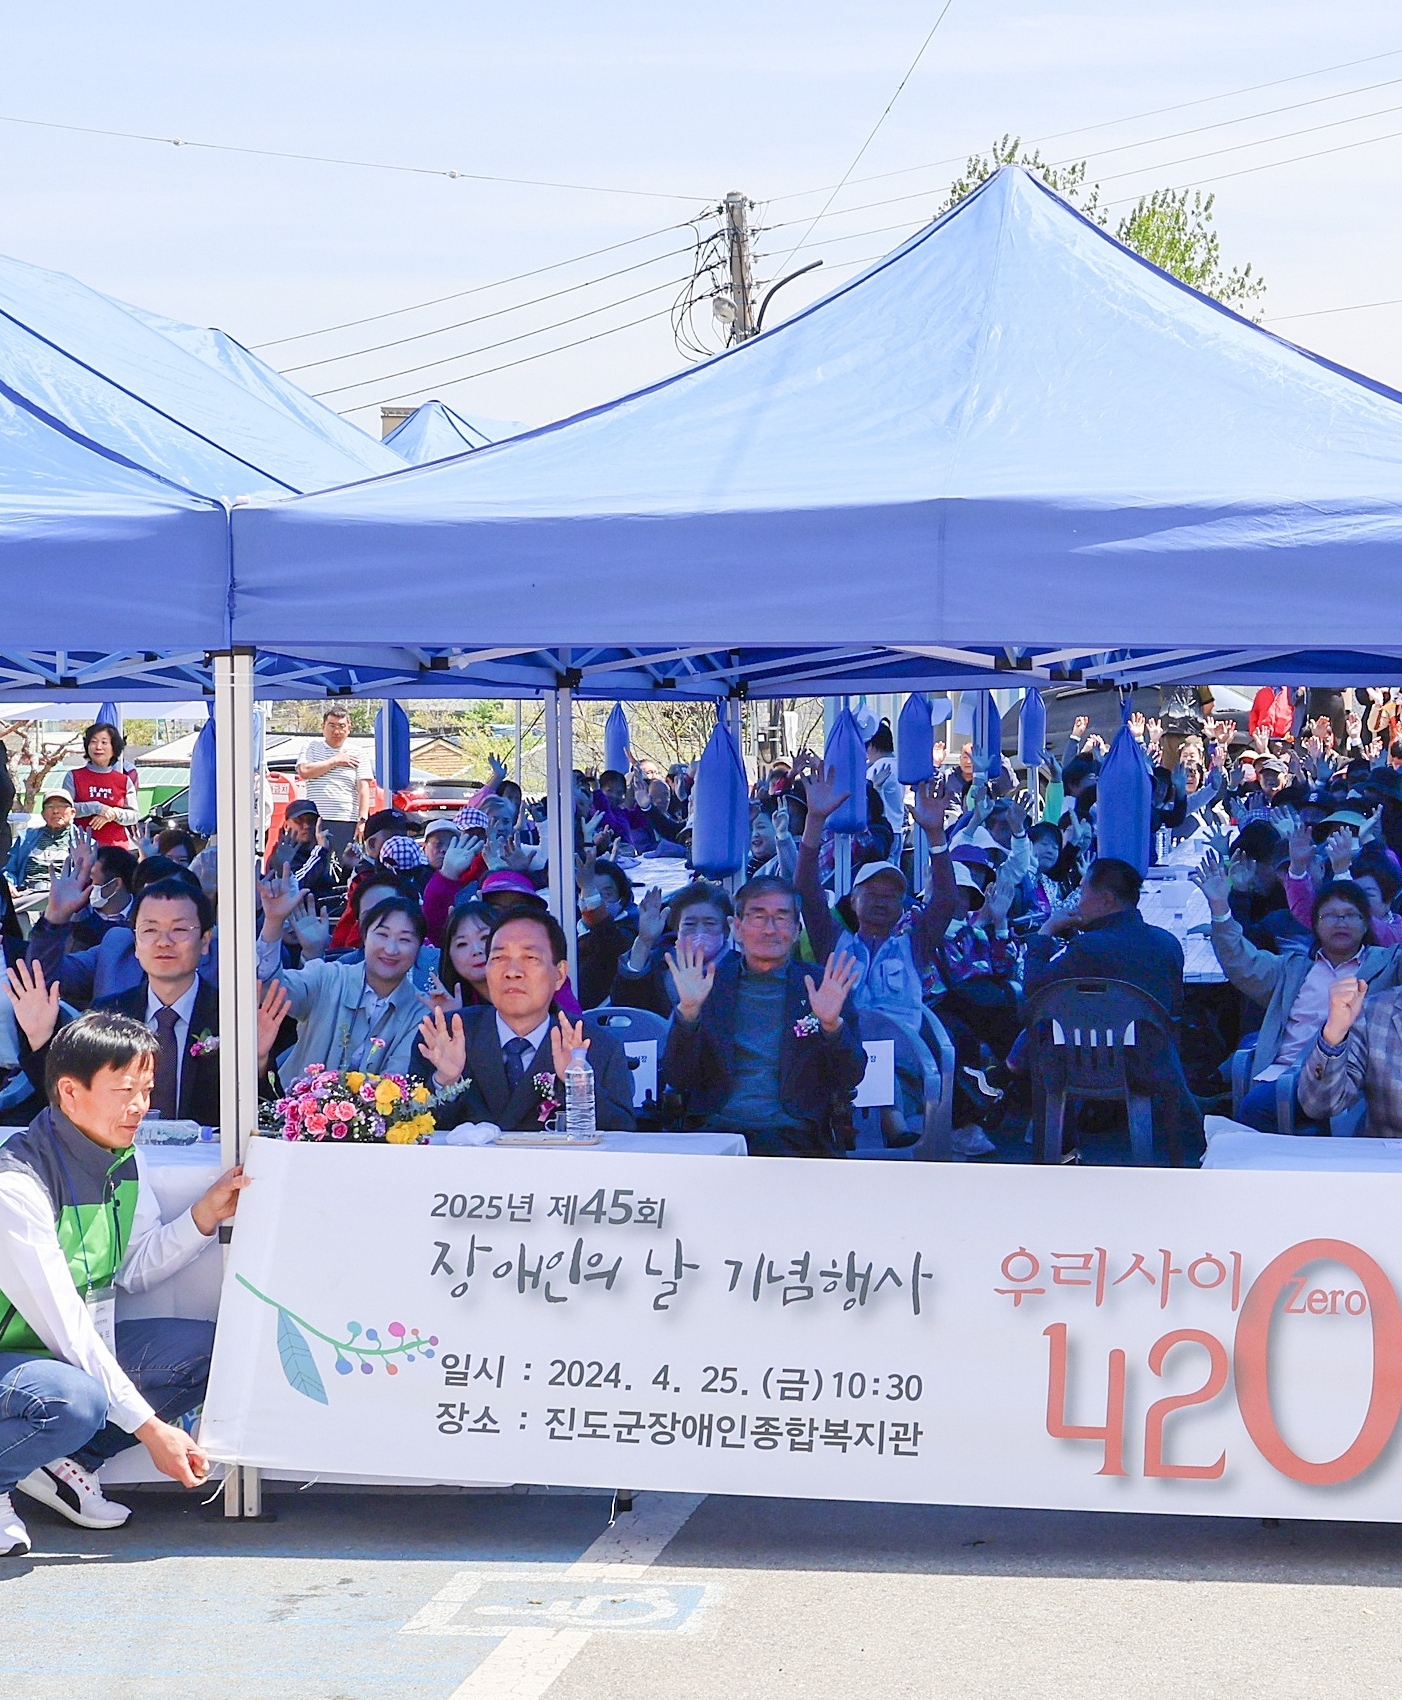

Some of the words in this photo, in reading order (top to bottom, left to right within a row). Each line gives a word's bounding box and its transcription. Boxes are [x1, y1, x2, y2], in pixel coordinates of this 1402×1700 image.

[430, 1192, 535, 1224] 2025년
[546, 1187, 667, 1229] 제45회
[430, 1234, 621, 1303] 장애인의
[645, 1238, 700, 1311] 날
[724, 1250, 934, 1316] 기념행사
[993, 1246, 1243, 1312] 우리사이
[1283, 1276, 1368, 1316] Zero
[440, 1353, 505, 1389] 일시
[548, 1358, 632, 1391] 2024.
[651, 1364, 680, 1393] 4.
[435, 1402, 500, 1436] 장소
[544, 1406, 925, 1458] 진도군장애인종합복지관
